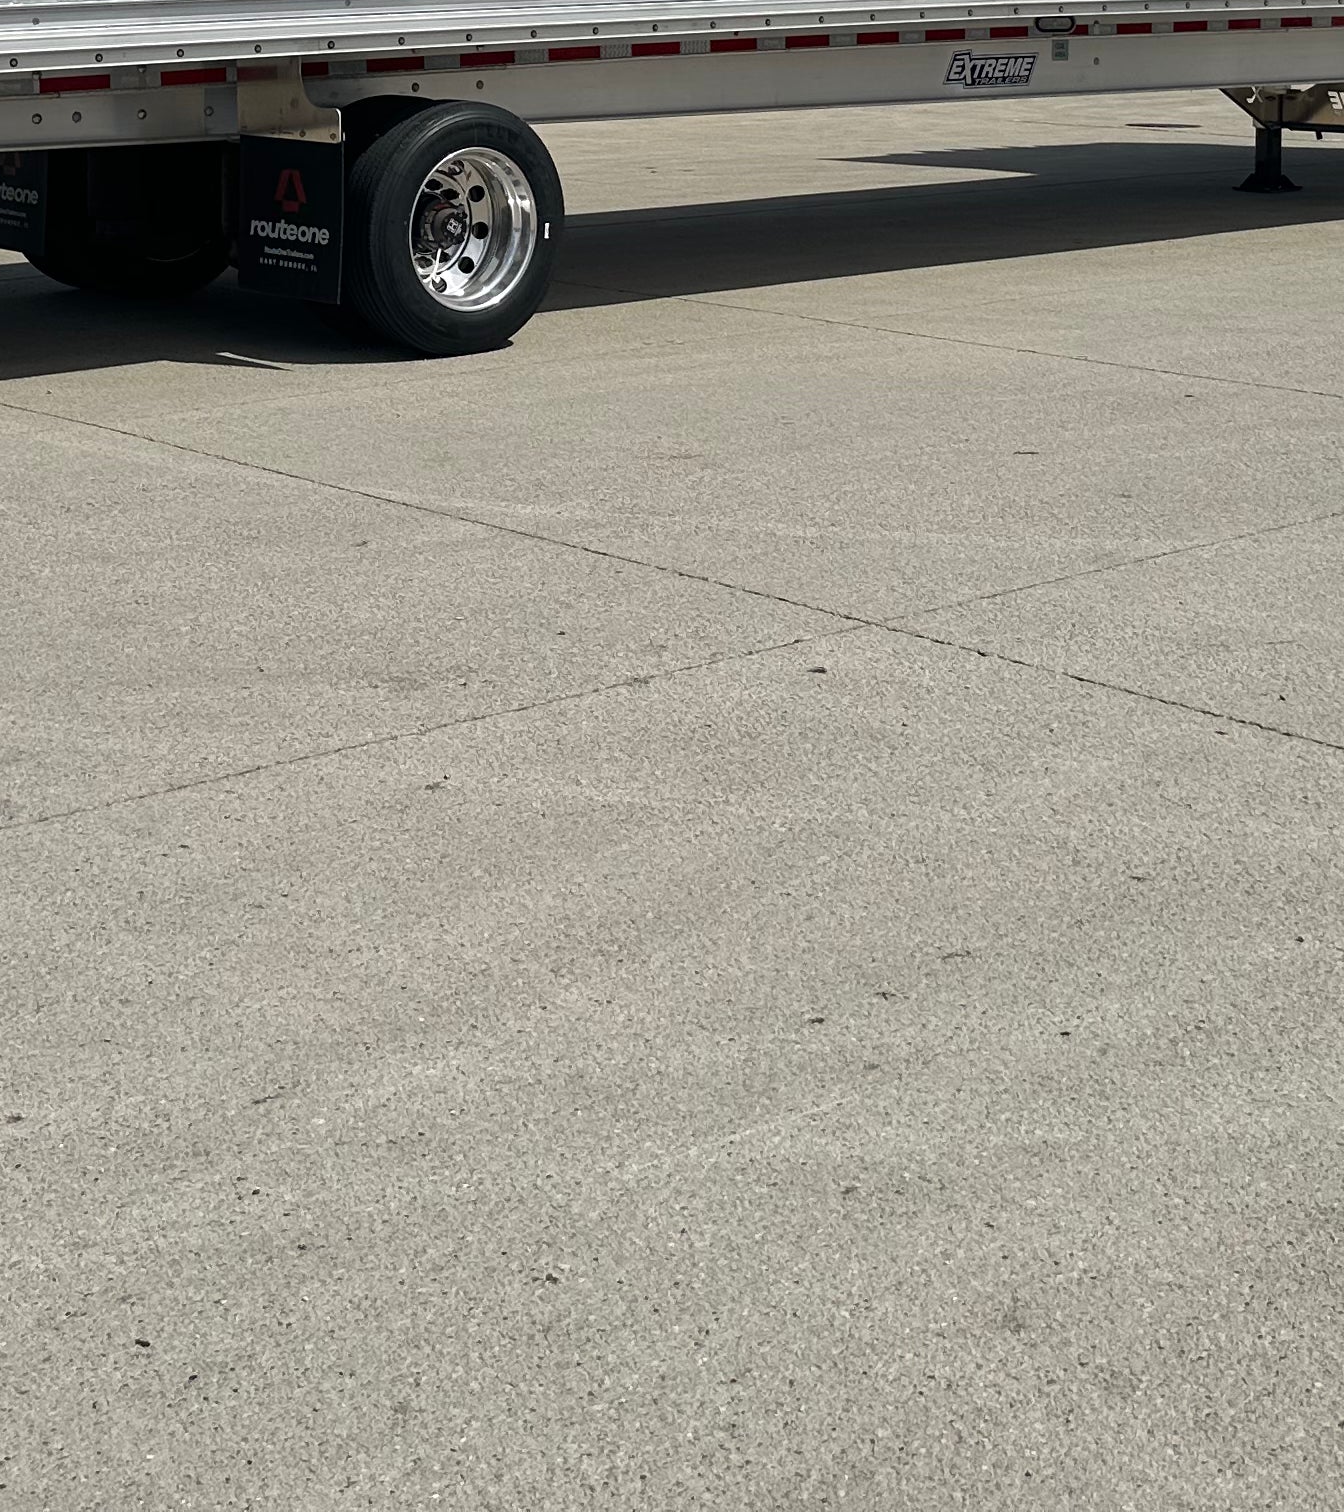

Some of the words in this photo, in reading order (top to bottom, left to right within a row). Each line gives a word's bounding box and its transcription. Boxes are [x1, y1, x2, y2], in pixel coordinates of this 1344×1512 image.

[948, 55, 1034, 84] EXTREME
[974, 76, 1028, 85] TRAILERS
[249, 219, 330, 245] routeone
